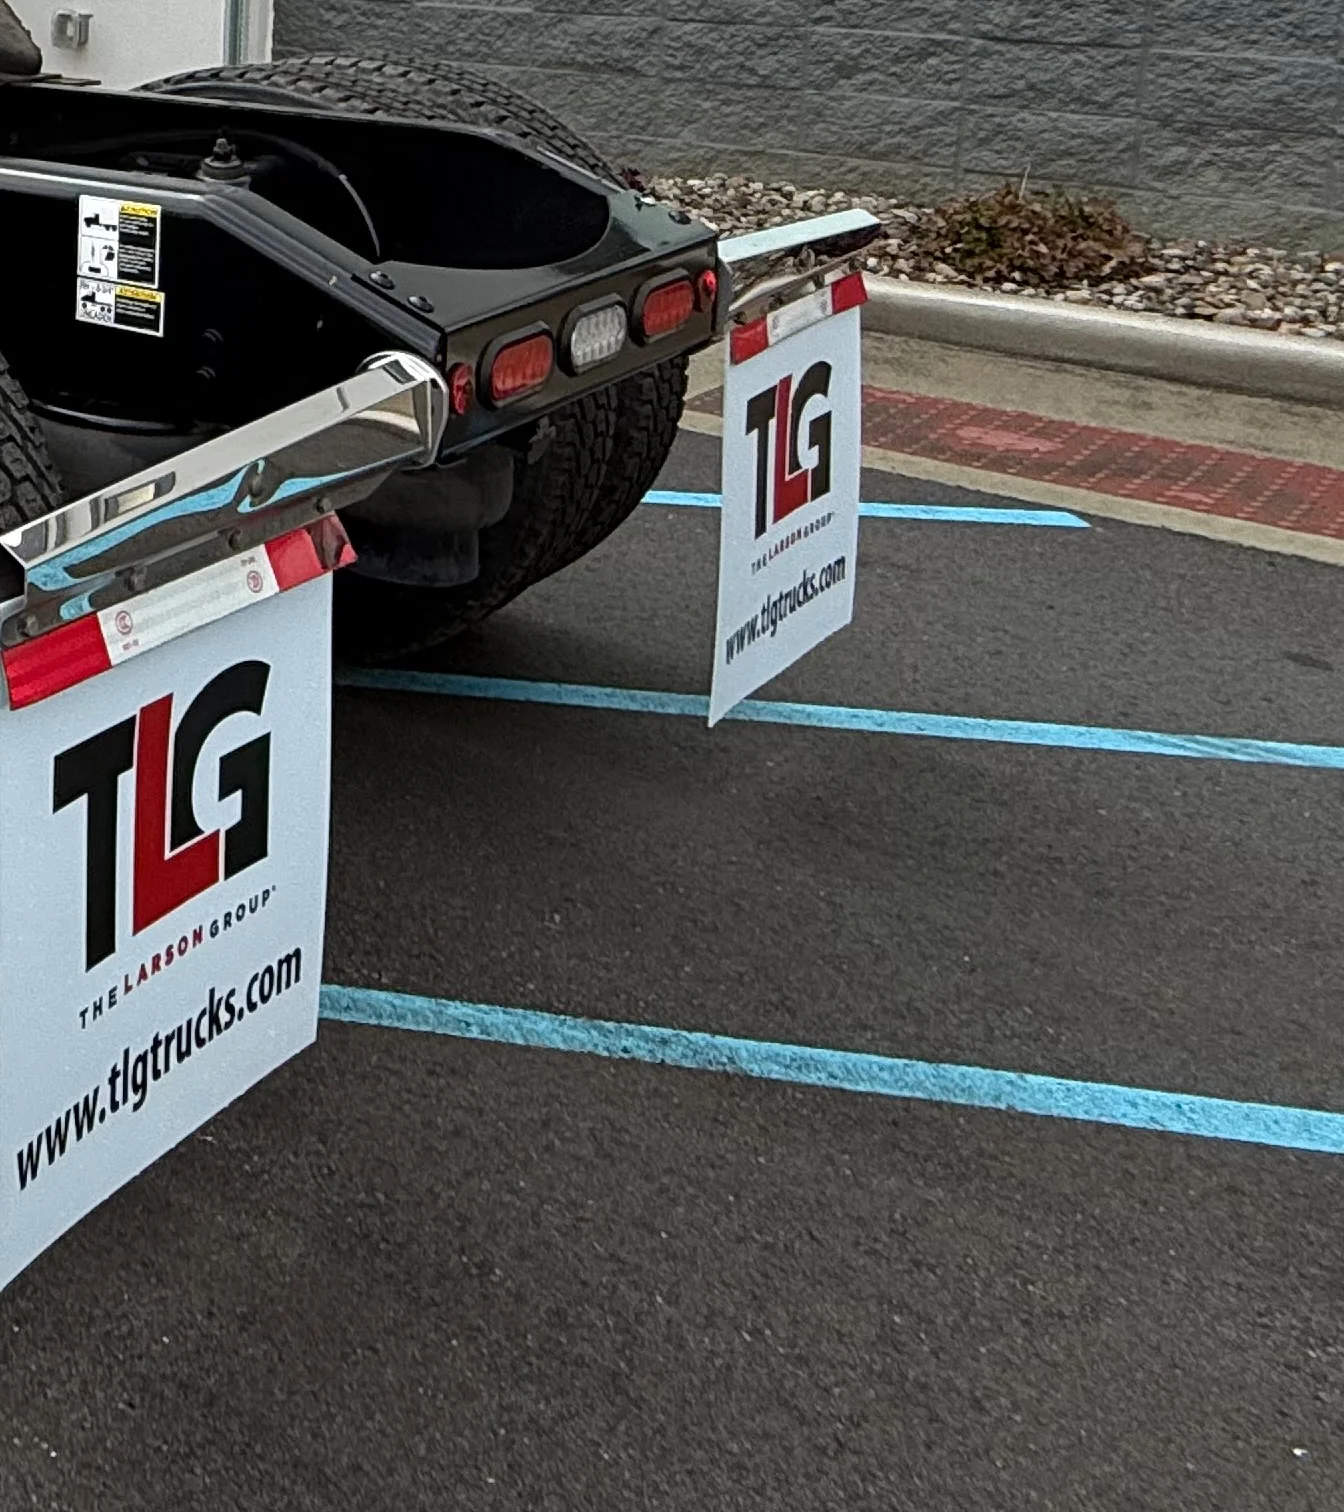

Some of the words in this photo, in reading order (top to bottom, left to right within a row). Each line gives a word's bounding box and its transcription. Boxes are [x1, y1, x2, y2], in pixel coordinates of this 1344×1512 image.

[746, 360, 832, 540] TLG
[725, 555, 846, 665] www.tlgtrucks.com
[751, 556, 767, 575] THE
[769, 529, 802, 559] LARSON
[52, 659, 272, 974] TLG
[79, 985, 118, 1029] THE
[123, 924, 203, 995] LARSON
[15, 946, 302, 1191] www.tlgtrucks.com
